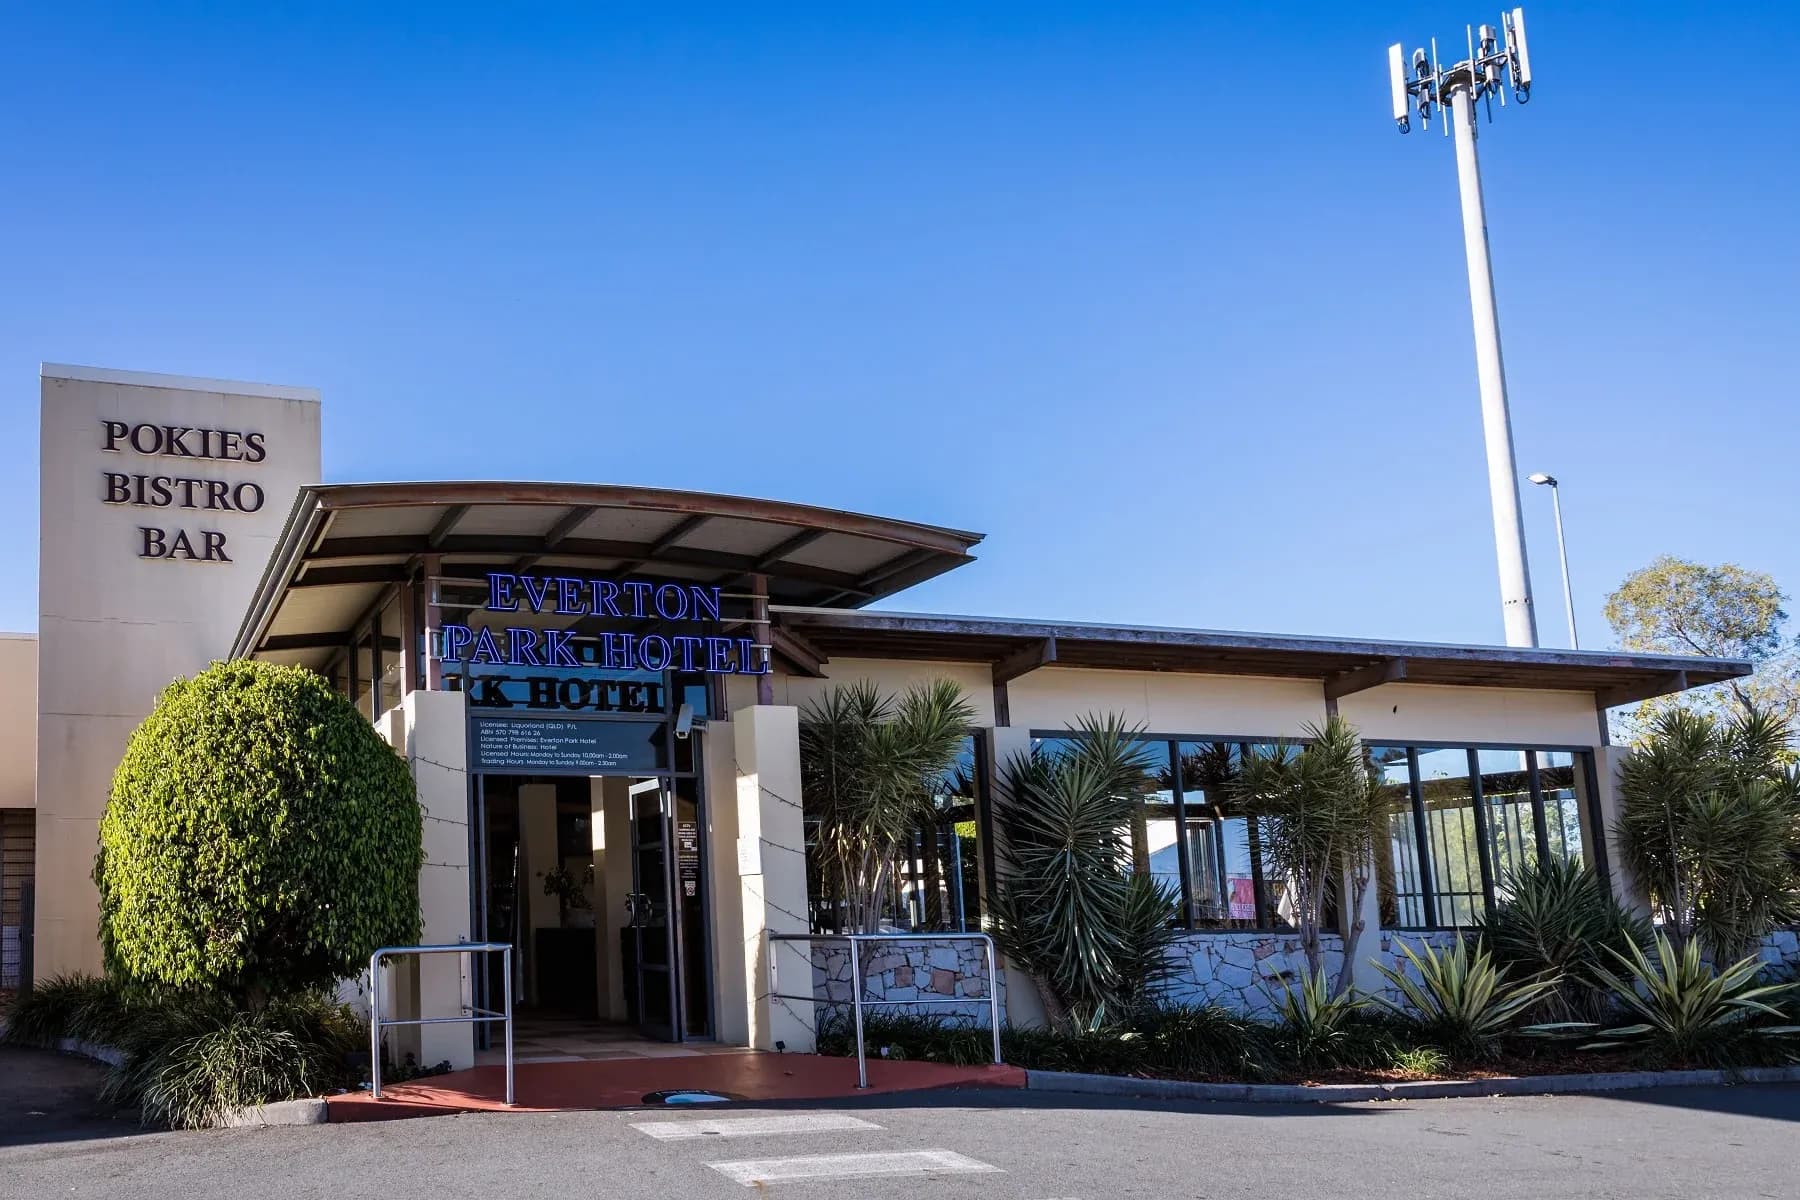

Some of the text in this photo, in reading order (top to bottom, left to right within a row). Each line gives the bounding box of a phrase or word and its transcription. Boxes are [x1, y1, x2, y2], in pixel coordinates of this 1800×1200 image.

[101, 420, 267, 463] POKIES
[103, 472, 265, 514] BISTRO
[139, 526, 233, 564] BAR
[485, 572, 722, 623] EVERTON
[441, 624, 770, 675] PARK HOTEL
[481, 757, 505, 766] Trading
[555, 759, 575, 767] Sunday
